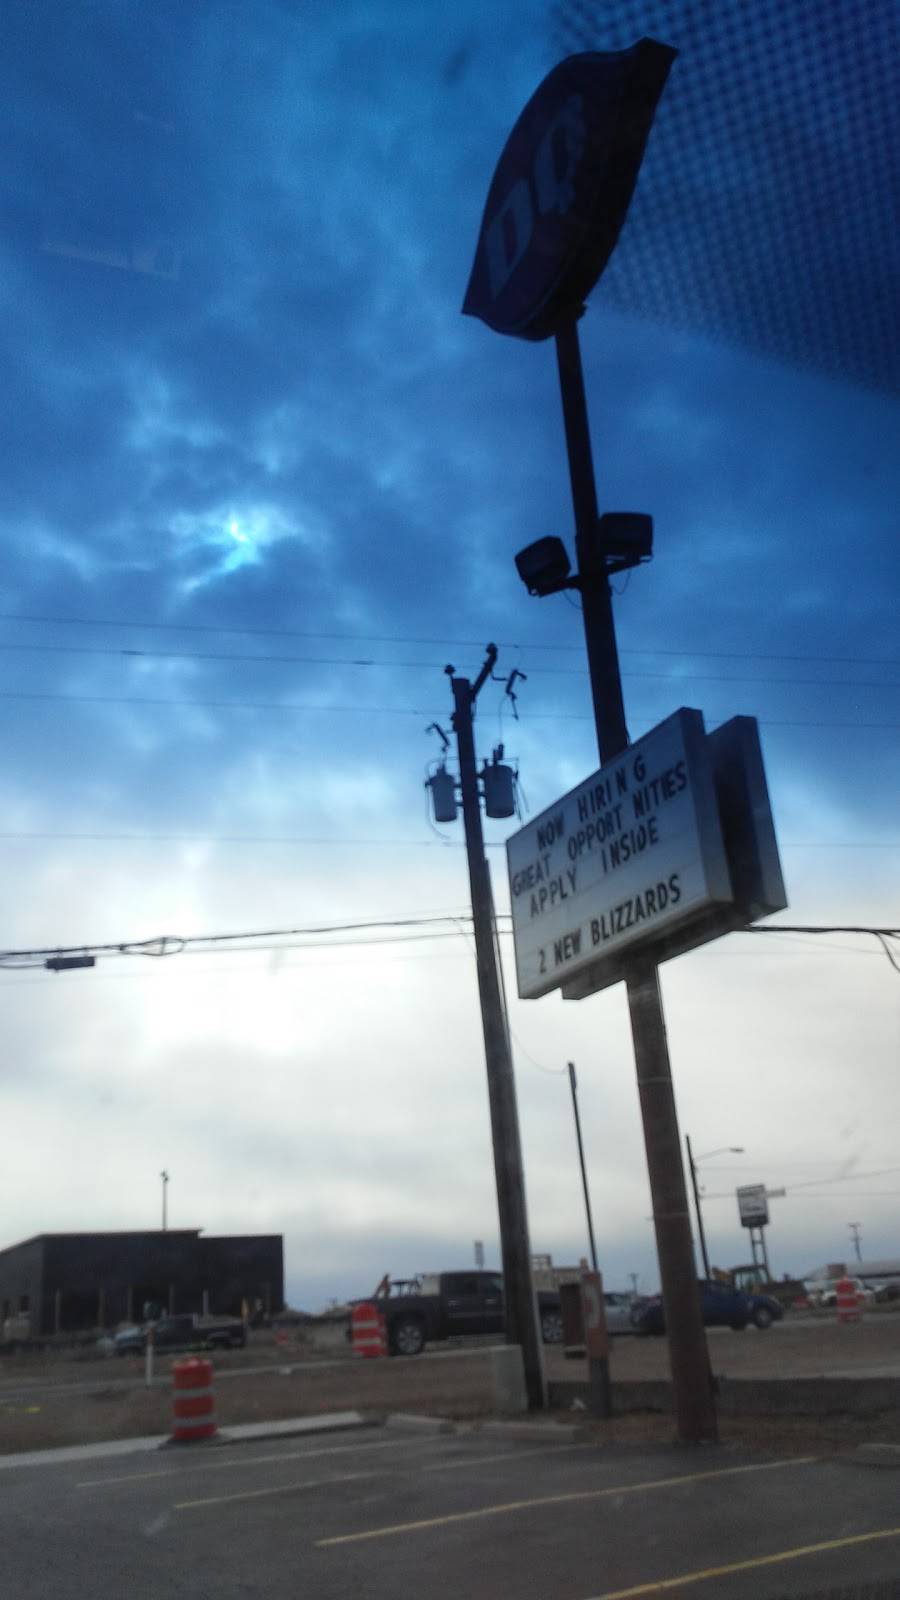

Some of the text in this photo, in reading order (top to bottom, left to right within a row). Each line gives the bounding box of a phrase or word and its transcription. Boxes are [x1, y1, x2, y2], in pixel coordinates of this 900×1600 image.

[484, 93, 588, 298] DQ
[536, 754, 647, 851] NOW HIRING
[511, 852, 552, 897] GREAT
[530, 816, 660, 918] APPLY INSIDE
[538, 873, 682, 974] 2 NEW BLIZZARDS
